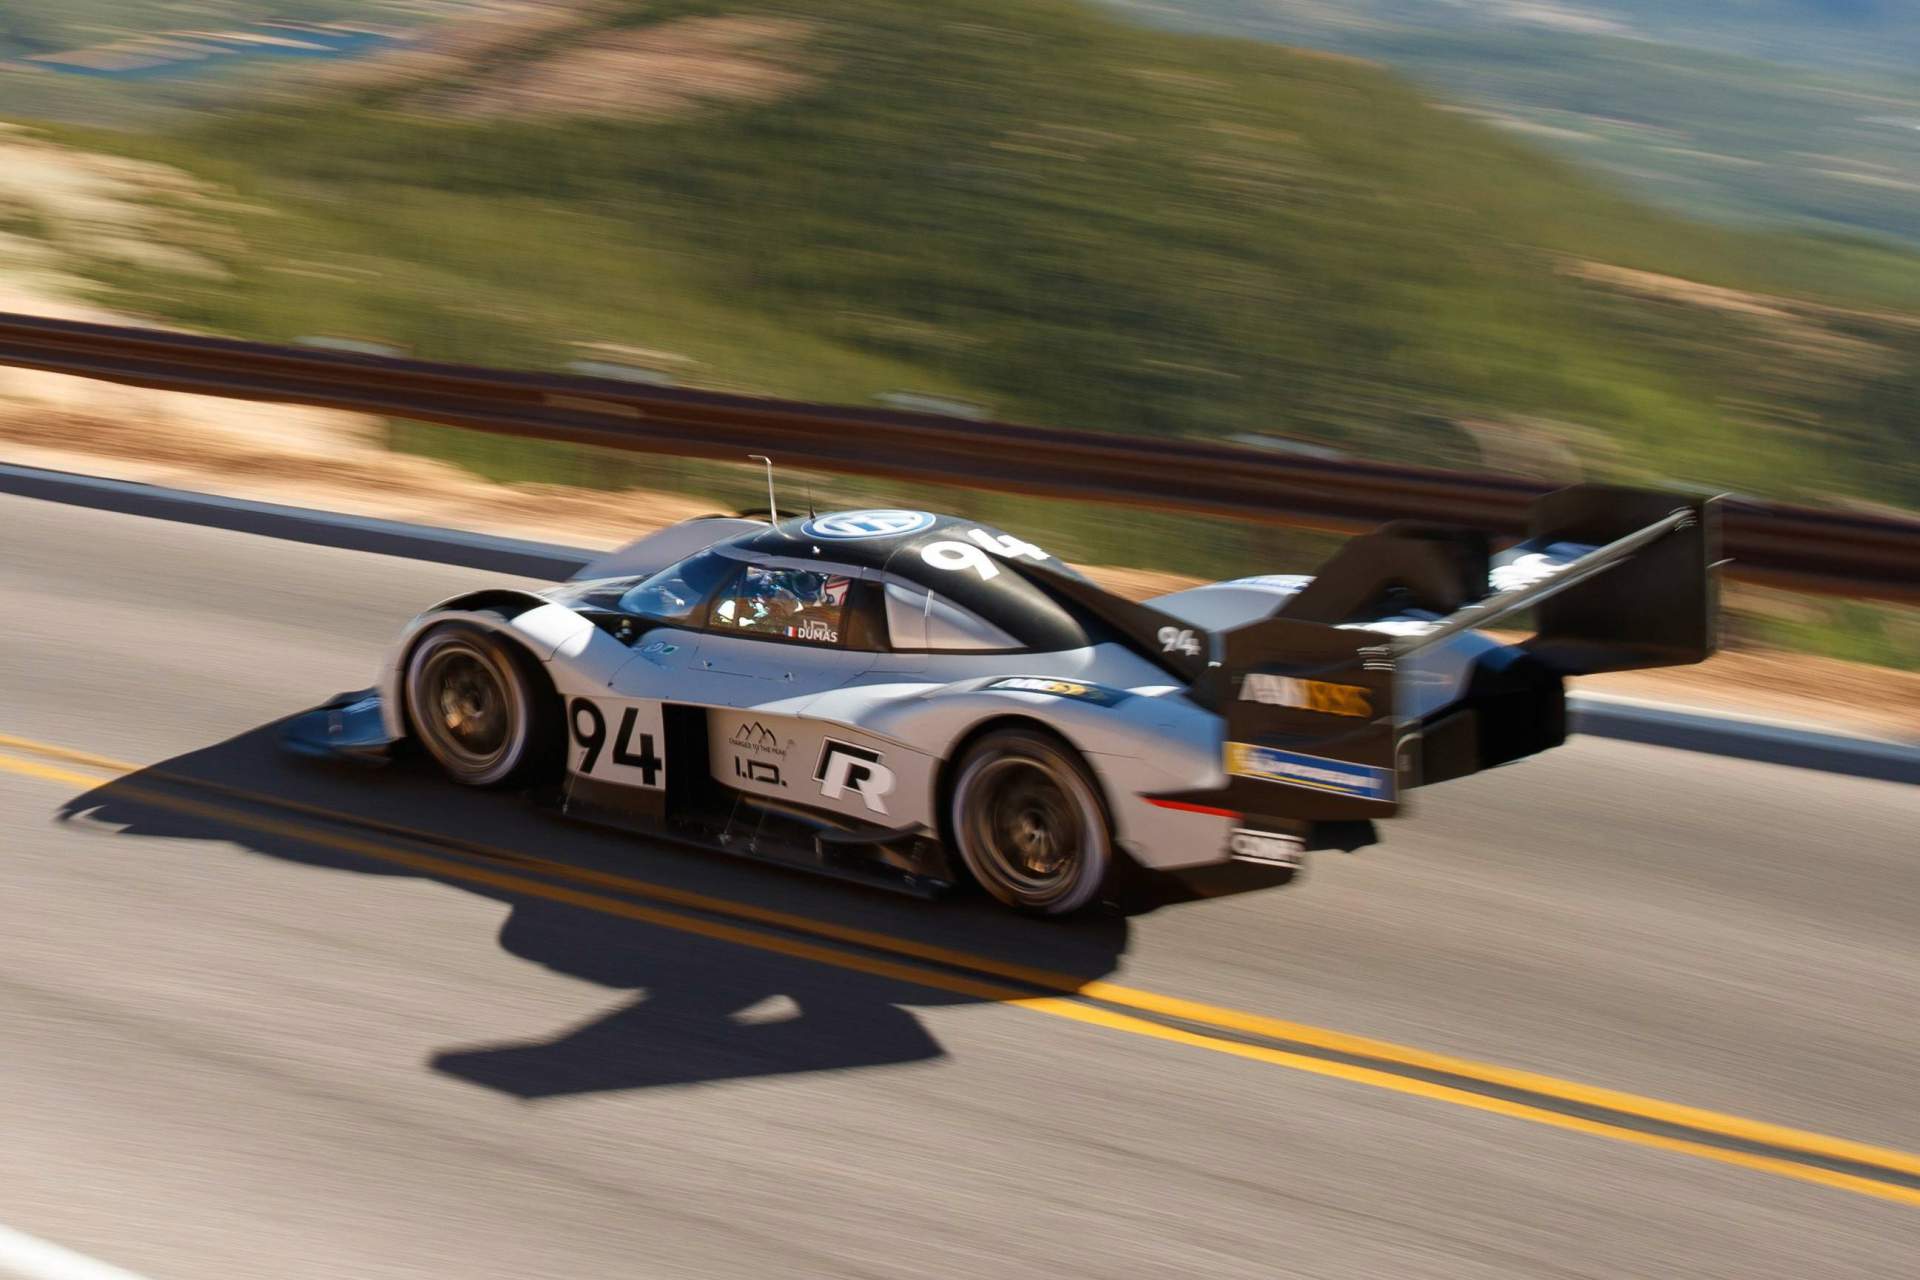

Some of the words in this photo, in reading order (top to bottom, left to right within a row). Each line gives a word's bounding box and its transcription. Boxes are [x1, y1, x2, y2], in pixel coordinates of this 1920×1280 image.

[921, 528, 1050, 580] 94
[798, 627, 839, 642] DUMAS
[1157, 626, 1201, 656] 94
[569, 697, 662, 786] 94
[735, 755, 788, 787] I.D.
[811, 735, 897, 817] R
